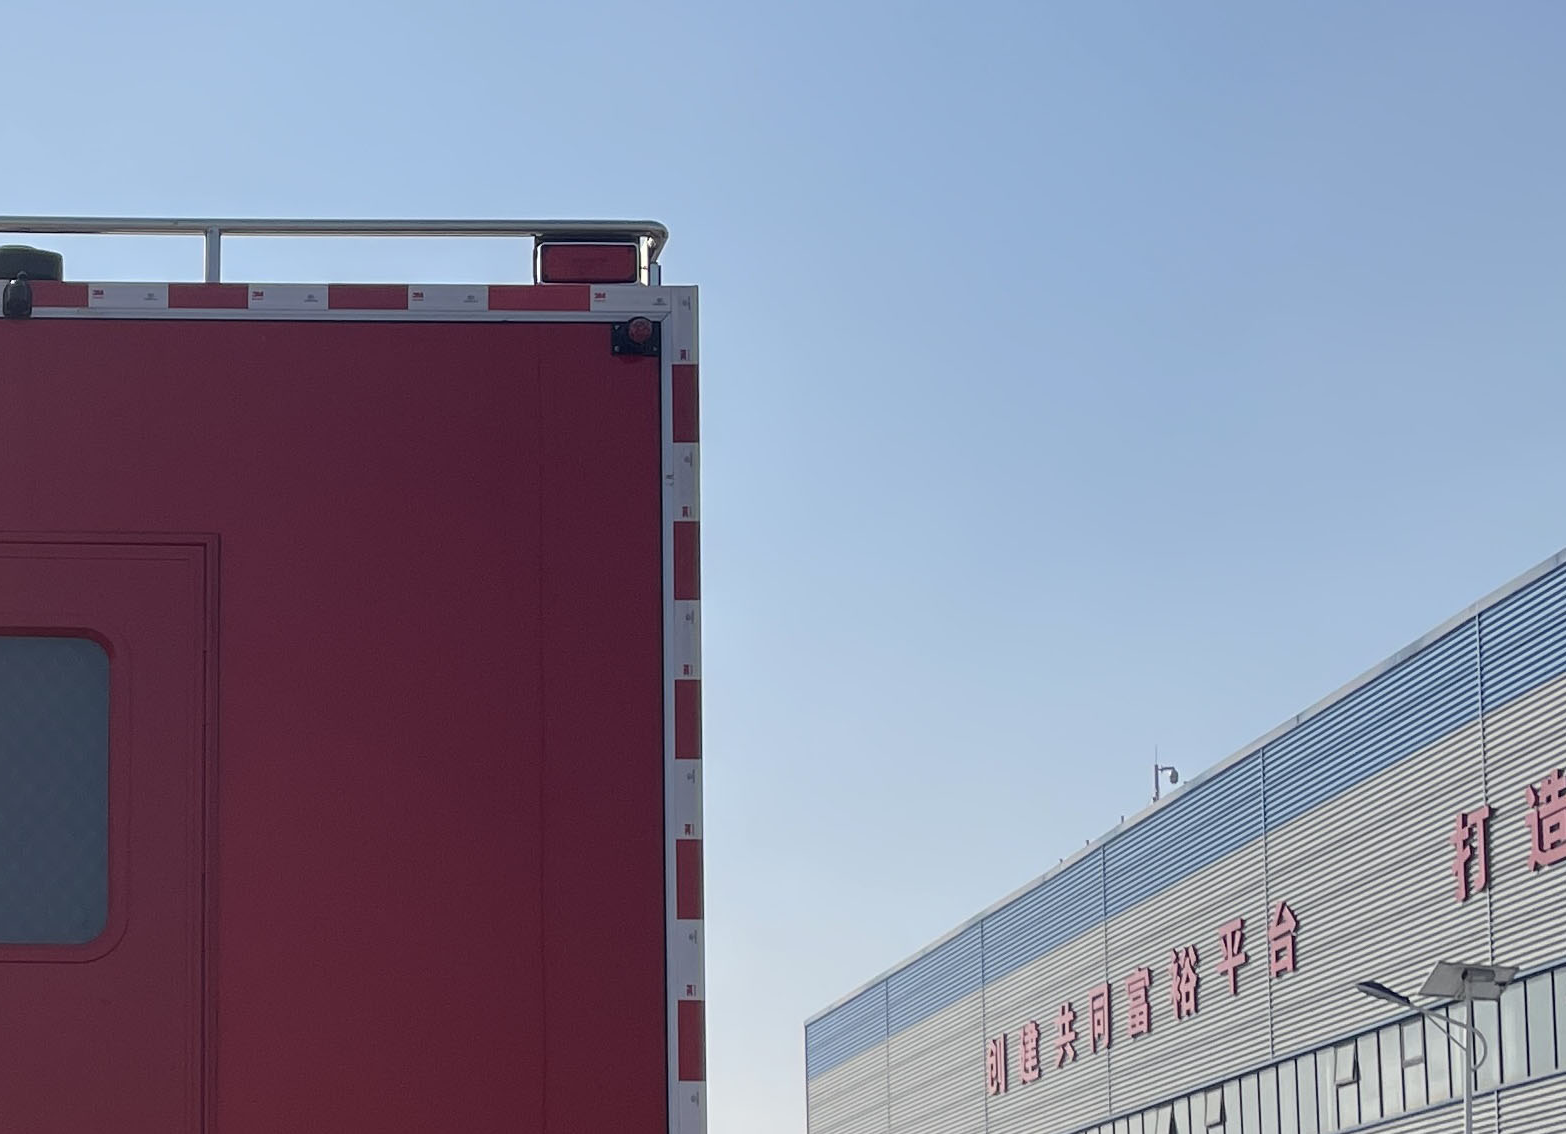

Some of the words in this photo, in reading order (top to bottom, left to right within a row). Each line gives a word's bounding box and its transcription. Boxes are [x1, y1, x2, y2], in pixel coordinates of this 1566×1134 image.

[987, 901, 1298, 1096] 创建共同富裕平台
